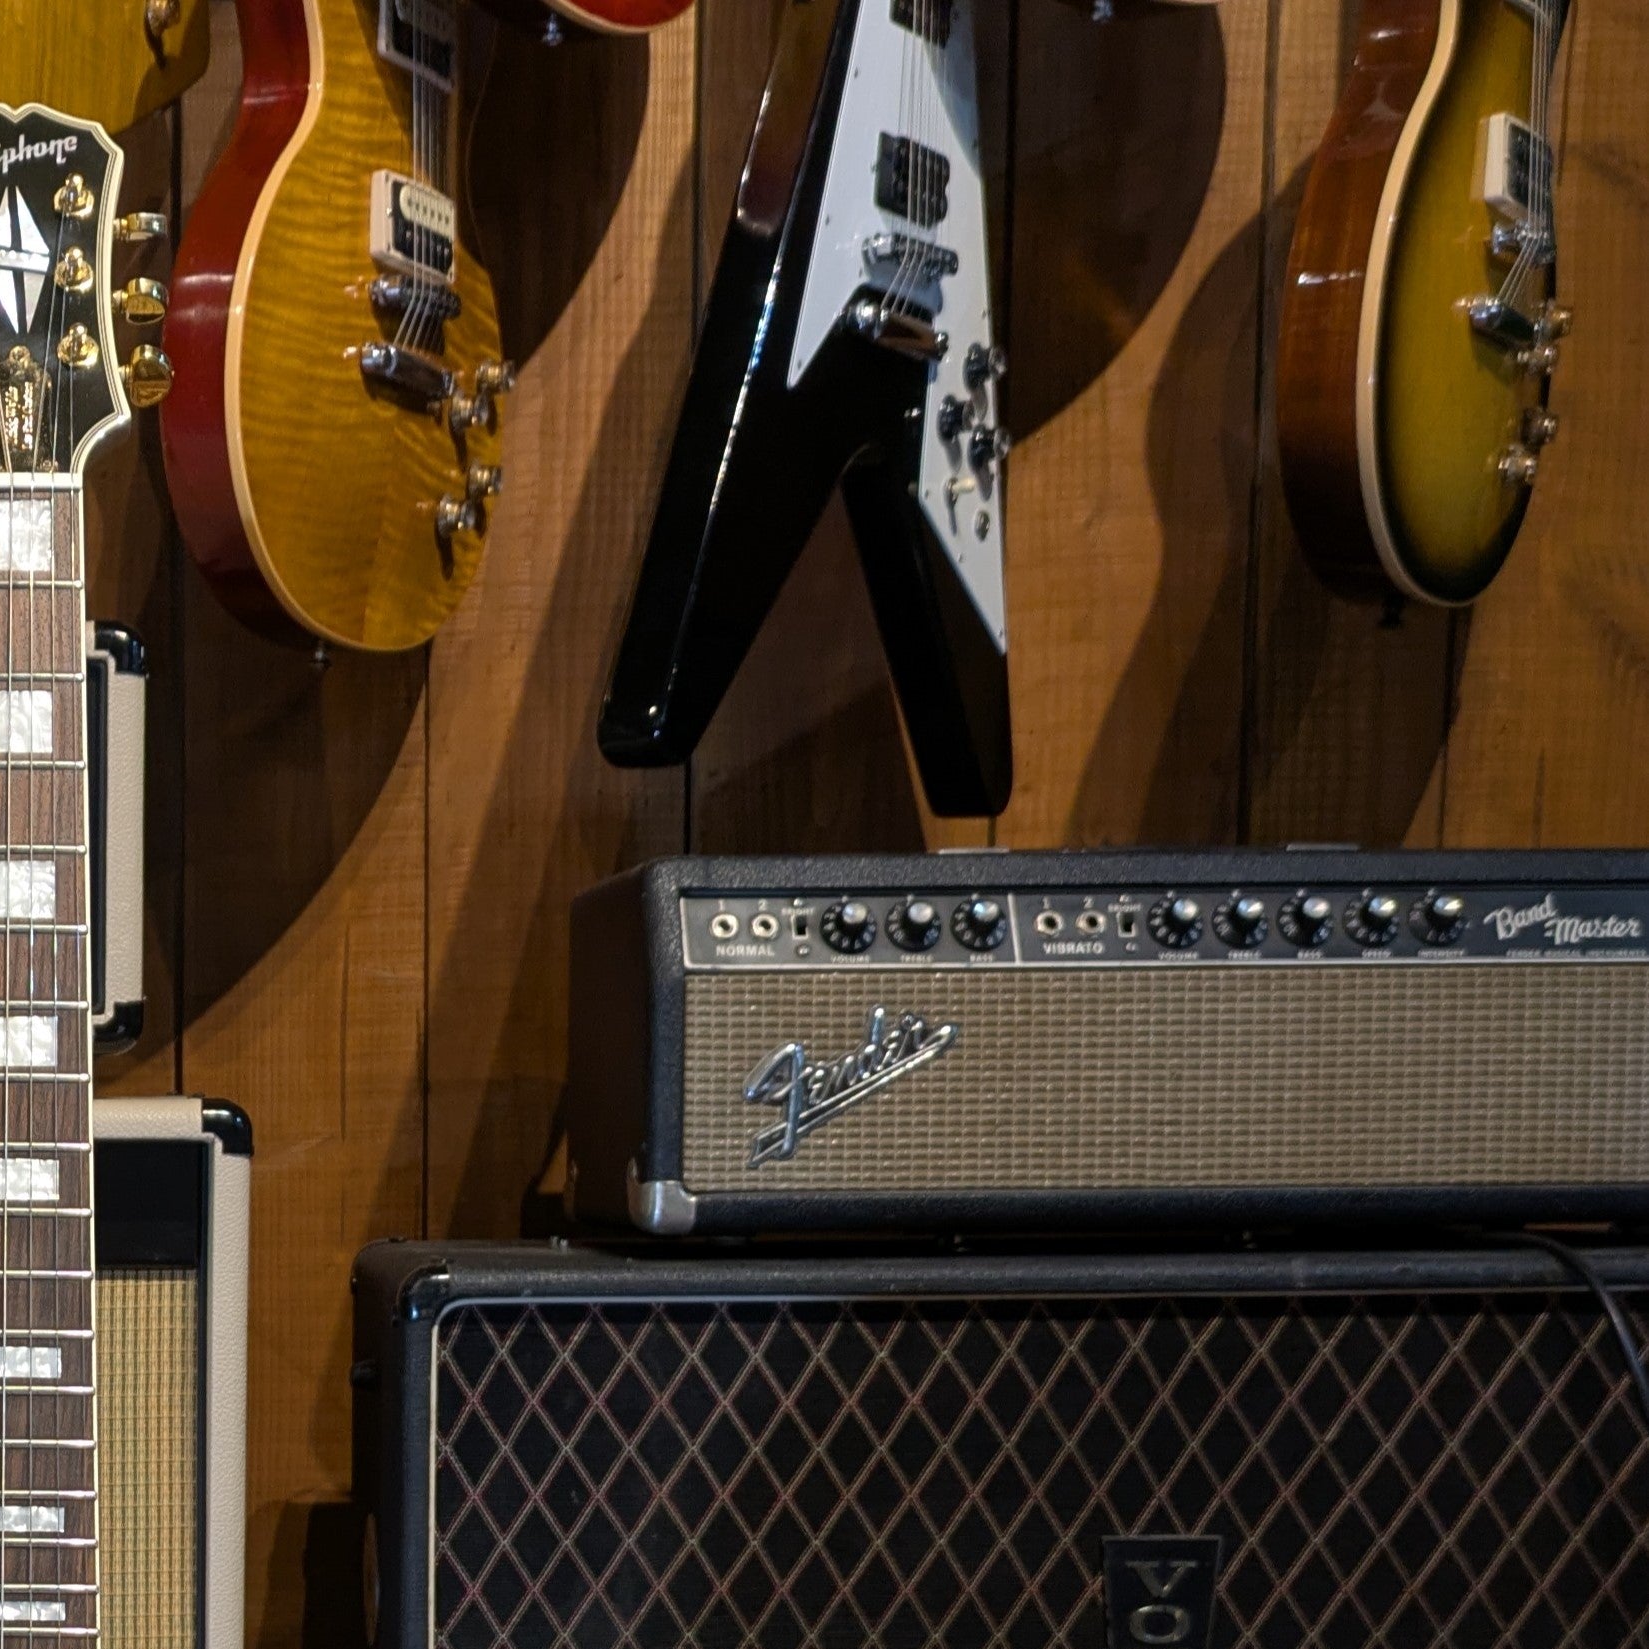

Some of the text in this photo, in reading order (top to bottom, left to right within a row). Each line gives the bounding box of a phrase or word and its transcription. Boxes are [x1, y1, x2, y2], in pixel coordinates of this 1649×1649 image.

[1483, 893, 1641, 946] Band Master
[716, 944, 775, 957] NORMAL
[1043, 942, 1103, 955] VIBRATO
